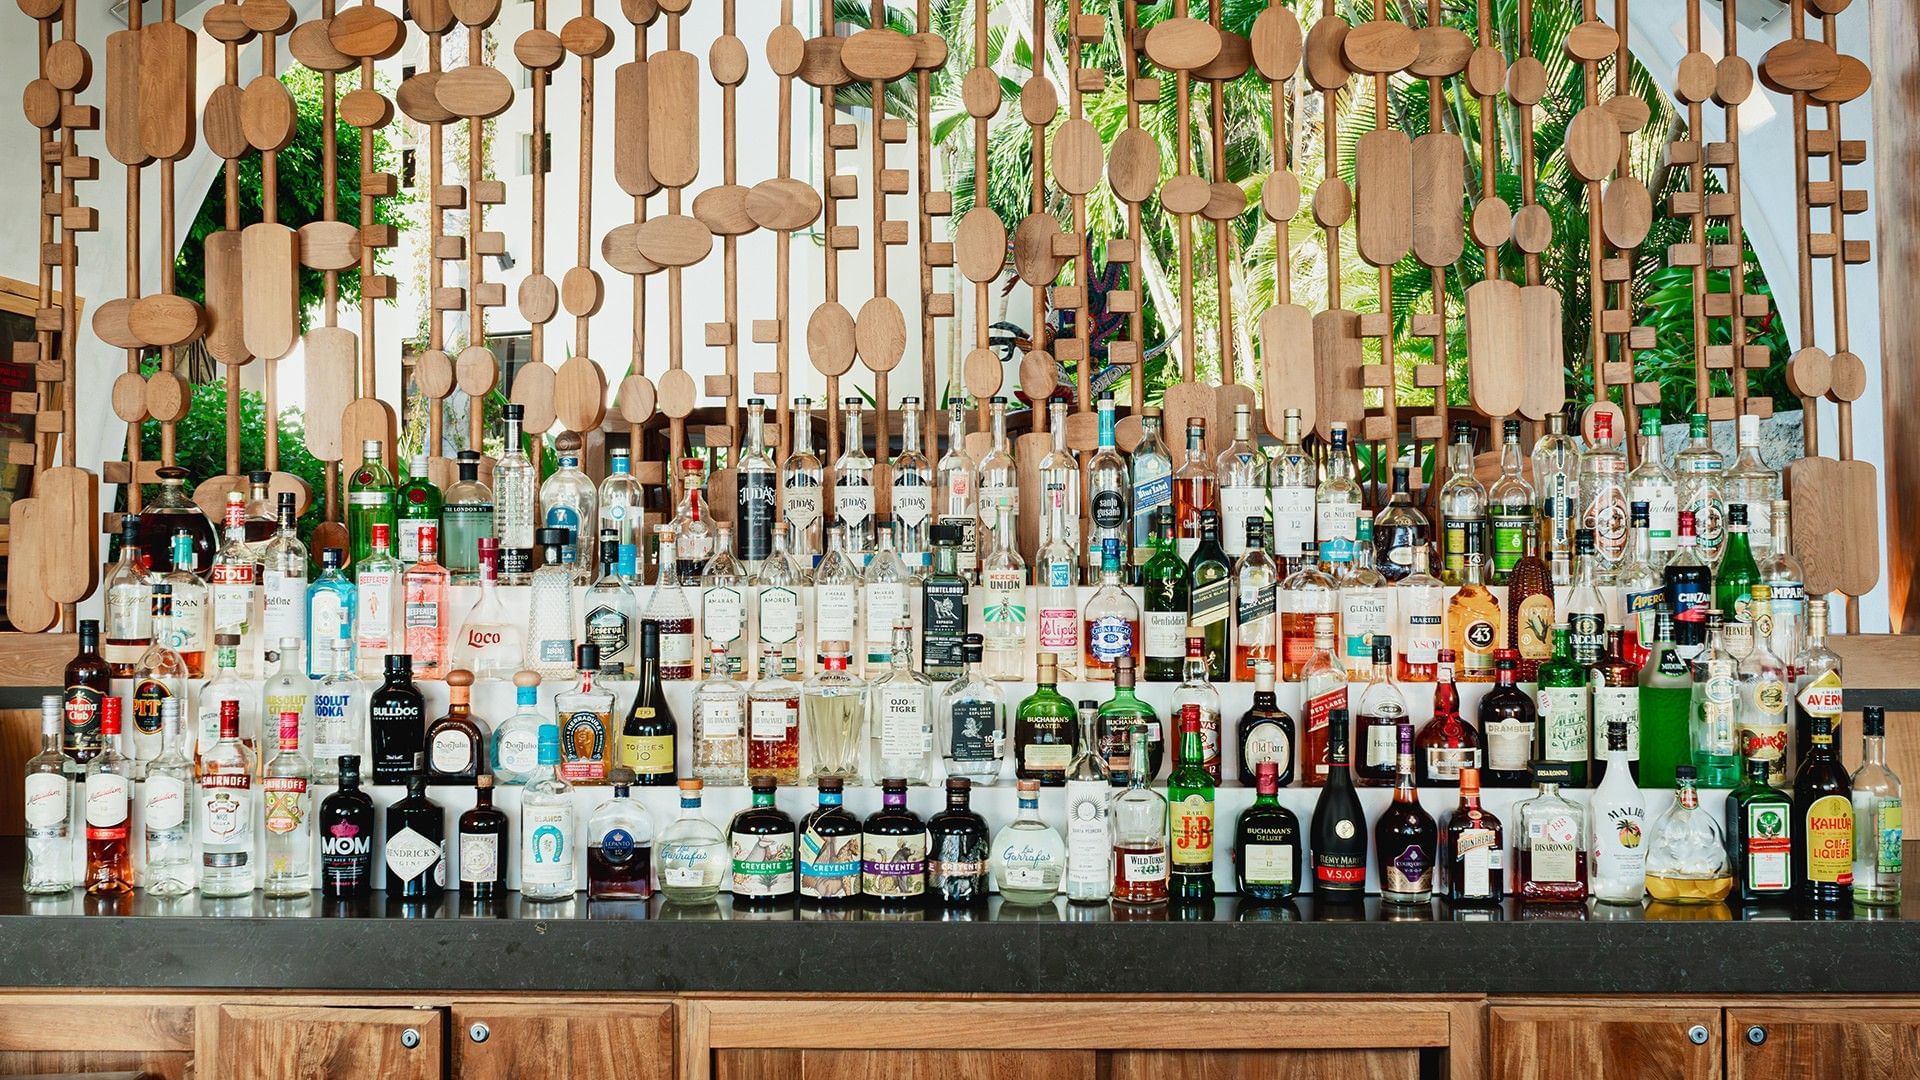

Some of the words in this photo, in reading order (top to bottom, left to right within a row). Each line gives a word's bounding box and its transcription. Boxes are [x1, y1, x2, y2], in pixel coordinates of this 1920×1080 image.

[739, 487, 776, 506] JUDAS
[787, 499, 815, 512] JUDAS
[840, 498, 867, 511] JUDAS
[899, 497, 926, 511] JUDAS
[1290, 520, 1301, 529] 12
[214, 567, 250, 581] STOLI
[989, 573, 1020, 581] MEZCAL
[359, 575, 390, 586] BEEFEATER
[926, 586, 964, 595] MONTELOBOS
[1631, 593, 1664, 609] APERO
[1349, 604, 1385, 614] GLENLIVET
[1151, 615, 1186, 627] Glenfiddich
[1363, 613, 1374, 621] 12
[1412, 616, 1441, 624] MARTELL
[1471, 627, 1490, 643] 43
[65, 701, 98, 712] Havana
[890, 698, 910, 707] OJO
[1310, 704, 1325, 715] RED
[1325, 698, 1347, 709] LABEL
[372, 706, 419, 718] BULLDOG
[889, 705, 917, 713] TIGRE
[68, 711, 89, 721] Club
[565, 713, 603, 732] HERRADURA
[1034, 722, 1063, 730] MASTER
[1487, 724, 1531, 734] DRAMBUIE
[626, 743, 664, 752] TORRES
[636, 752, 652, 761] 10
[1536, 769, 1569, 777] DISARONNO
[201, 774, 248, 788] SMIRNOFF
[263, 778, 305, 791] SMIRNOFF
[534, 815, 563, 823] BLANCO
[1176, 816, 1213, 850] J&B
[1247, 827, 1294, 836] BUCHANAN'S
[321, 836, 371, 856] MOM
[1459, 833, 1495, 853] COINTREAU
[1534, 843, 1573, 853] DISARONNO
[386, 848, 437, 859] HENDRICK'S
[1003, 846, 1052, 870] Garrafas
[1130, 855, 1149, 866] WILD
[739, 862, 782, 871] CREYENTE
[812, 863, 855, 873] CREYENTE
[873, 863, 916, 872] CREYENTE
